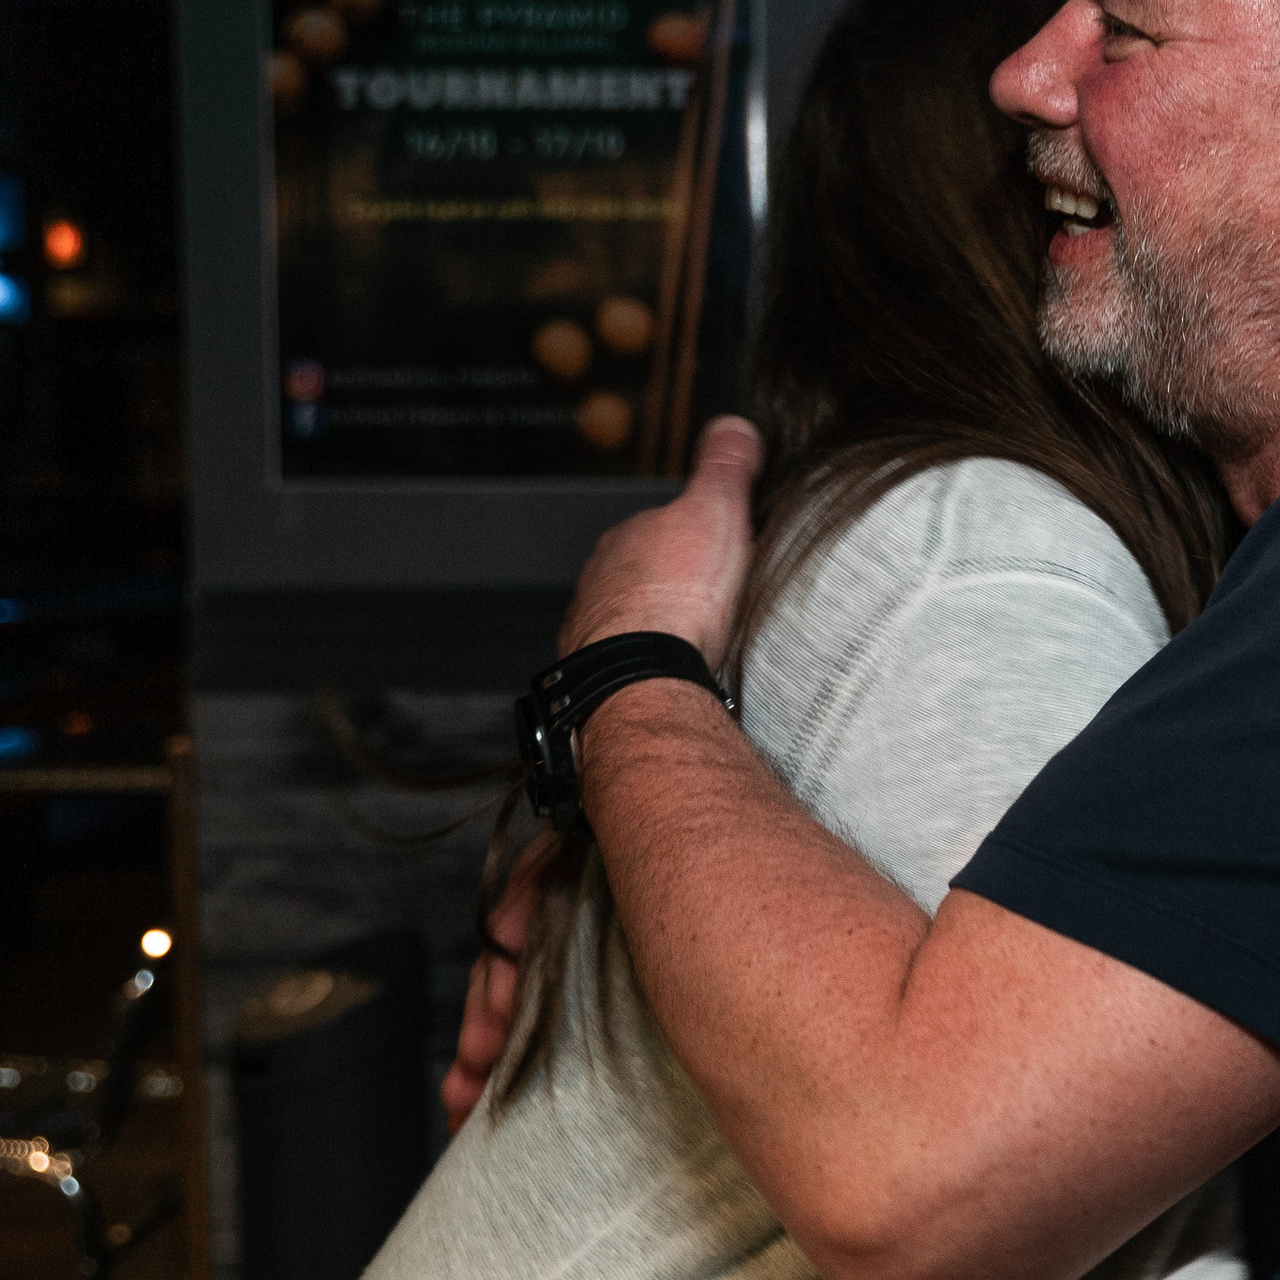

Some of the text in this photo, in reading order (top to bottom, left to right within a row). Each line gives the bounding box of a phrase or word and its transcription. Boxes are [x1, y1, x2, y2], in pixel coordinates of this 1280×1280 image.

[399, 0, 628, 31] THE PYRAMID
[331, 67, 695, 110] TOURNAMENT
